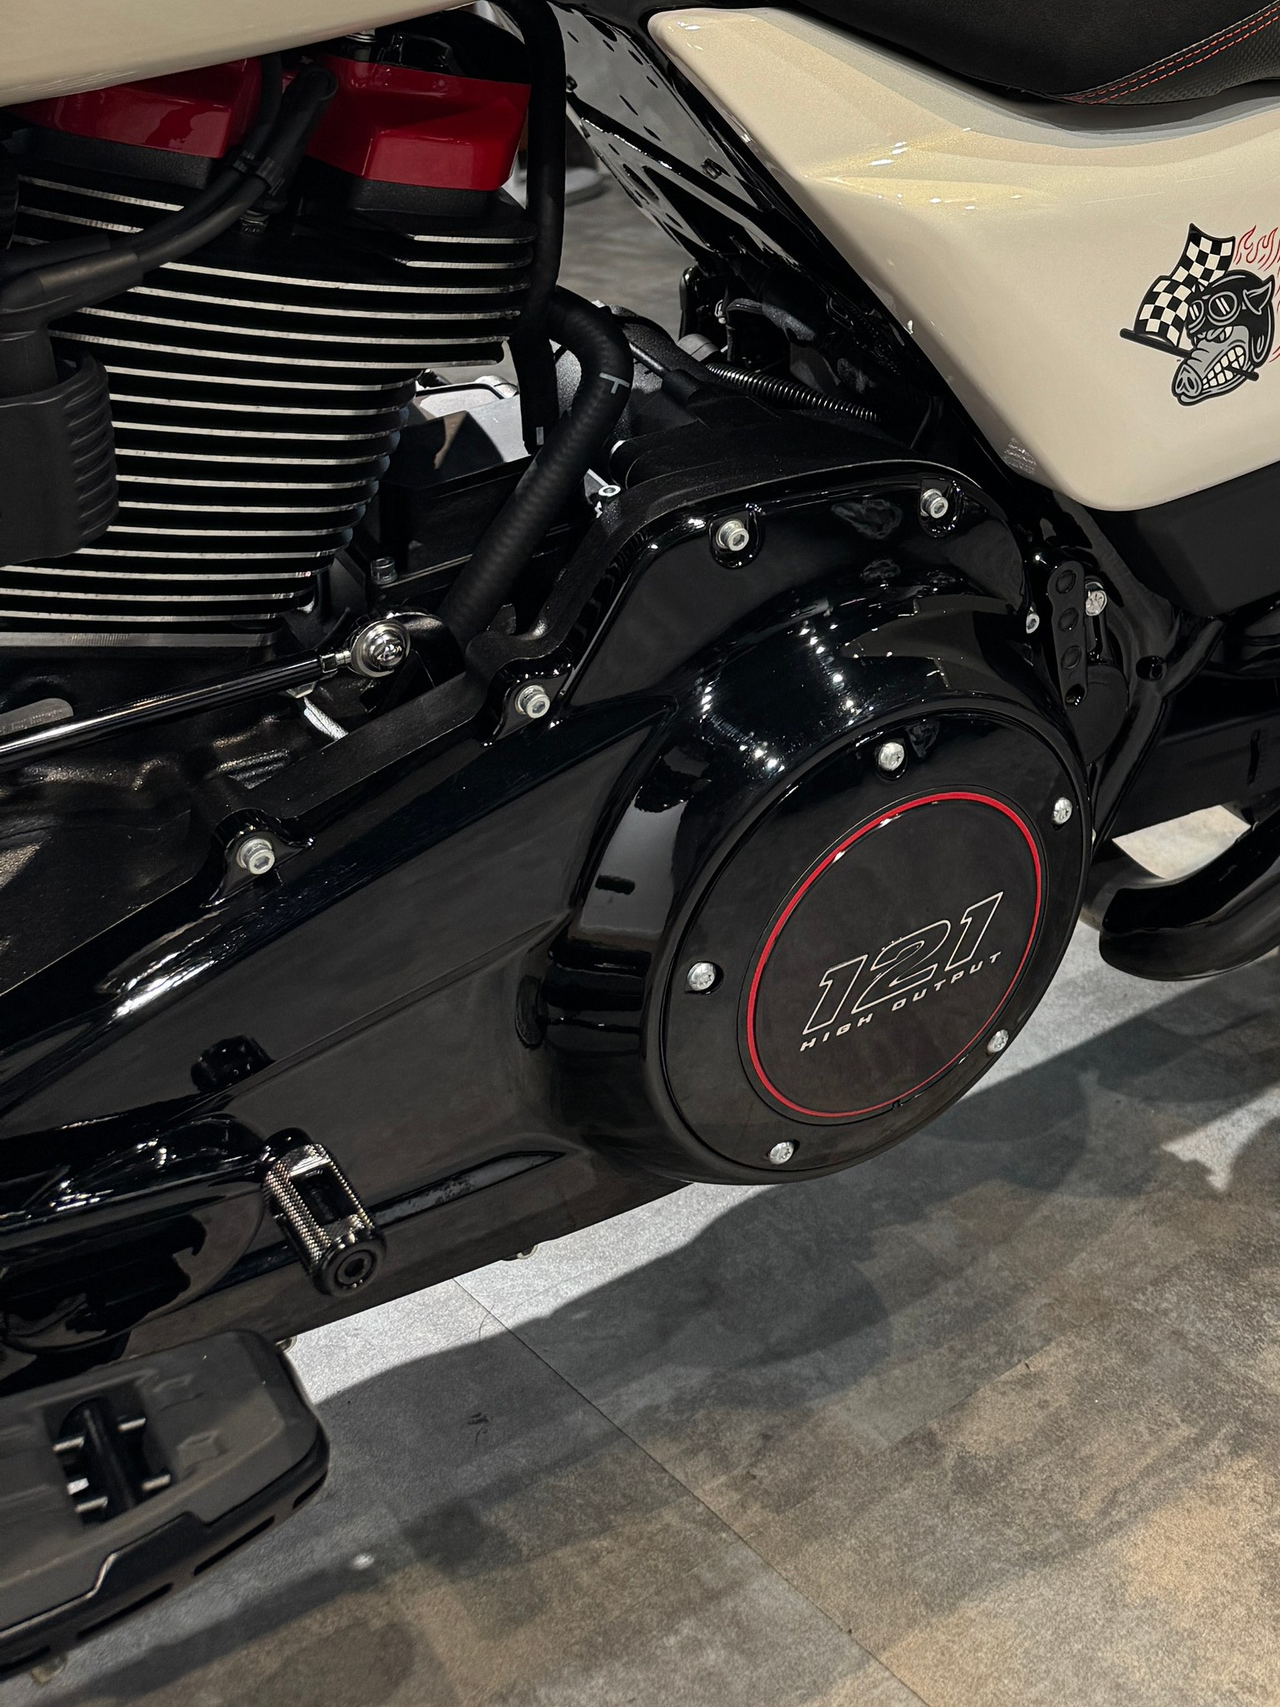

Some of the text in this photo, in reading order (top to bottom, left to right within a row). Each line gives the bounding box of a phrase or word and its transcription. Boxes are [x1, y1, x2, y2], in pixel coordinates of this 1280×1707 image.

[799, 951, 1002, 1053] HIGH OUTPUT
[802, 891, 1004, 1036] 121
